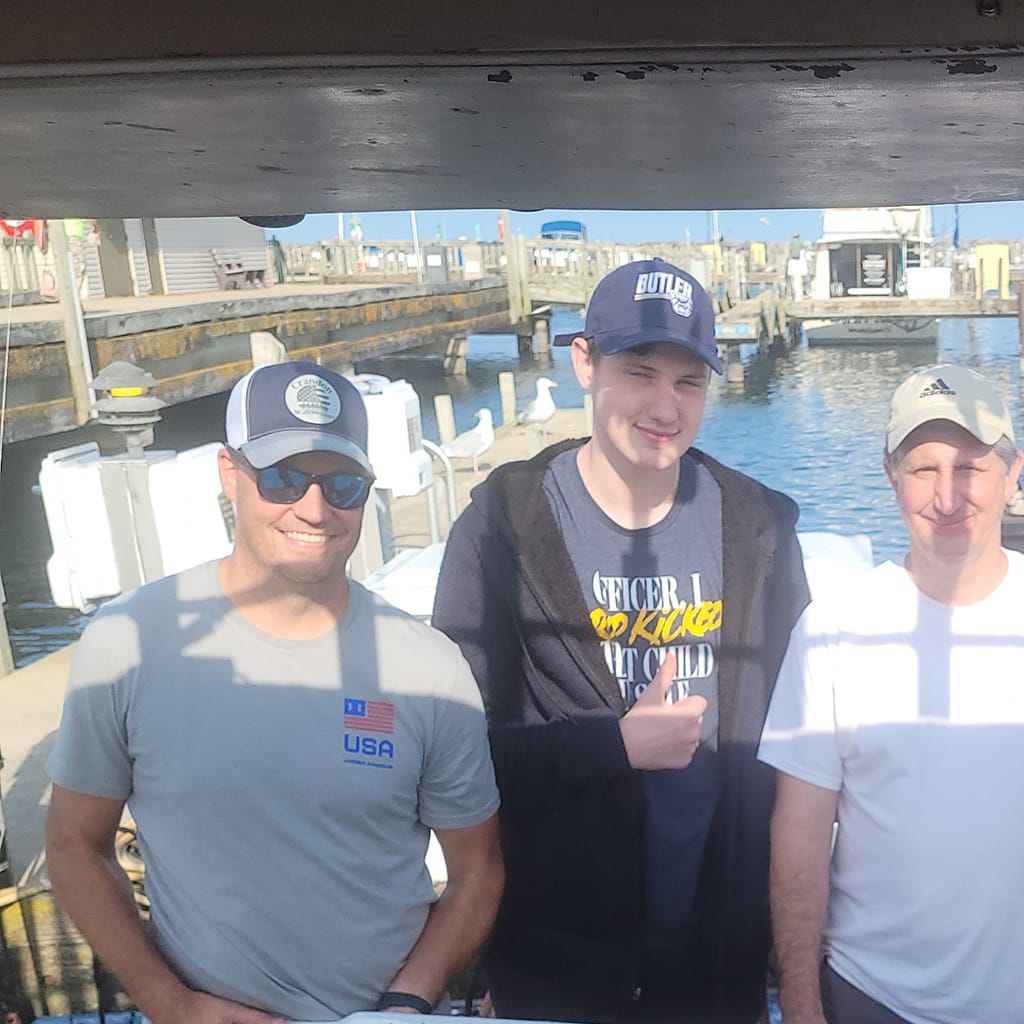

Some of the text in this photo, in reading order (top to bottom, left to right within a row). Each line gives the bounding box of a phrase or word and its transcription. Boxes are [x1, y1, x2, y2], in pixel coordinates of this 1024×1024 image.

[635, 271, 693, 298] BUTLER
[690, 572, 703, 608] I
[343, 733, 395, 759] USA
